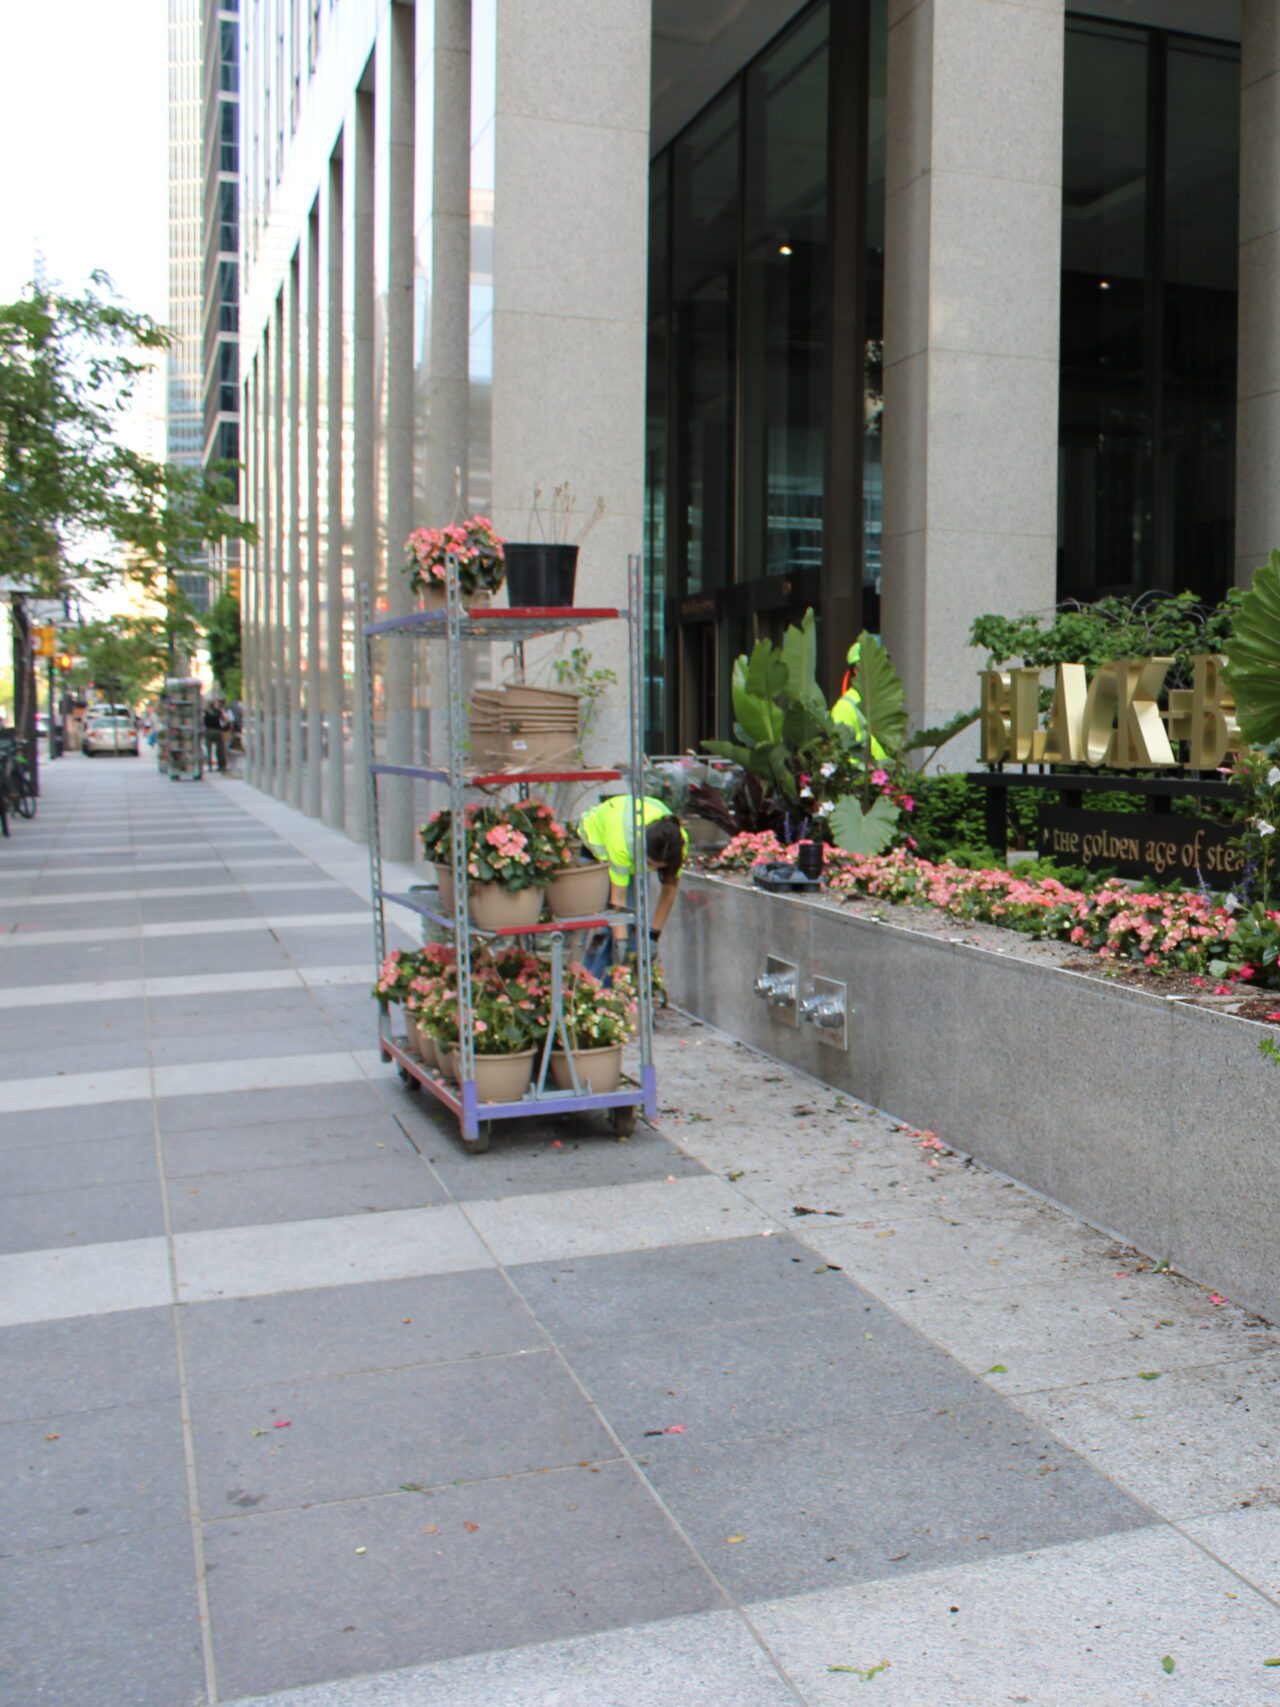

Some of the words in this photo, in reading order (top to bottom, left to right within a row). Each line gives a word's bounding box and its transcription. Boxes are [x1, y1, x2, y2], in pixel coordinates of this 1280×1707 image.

[1145, 840, 1177, 874] age
[1181, 829, 1205, 868] of
[1207, 843, 1246, 872] stea
